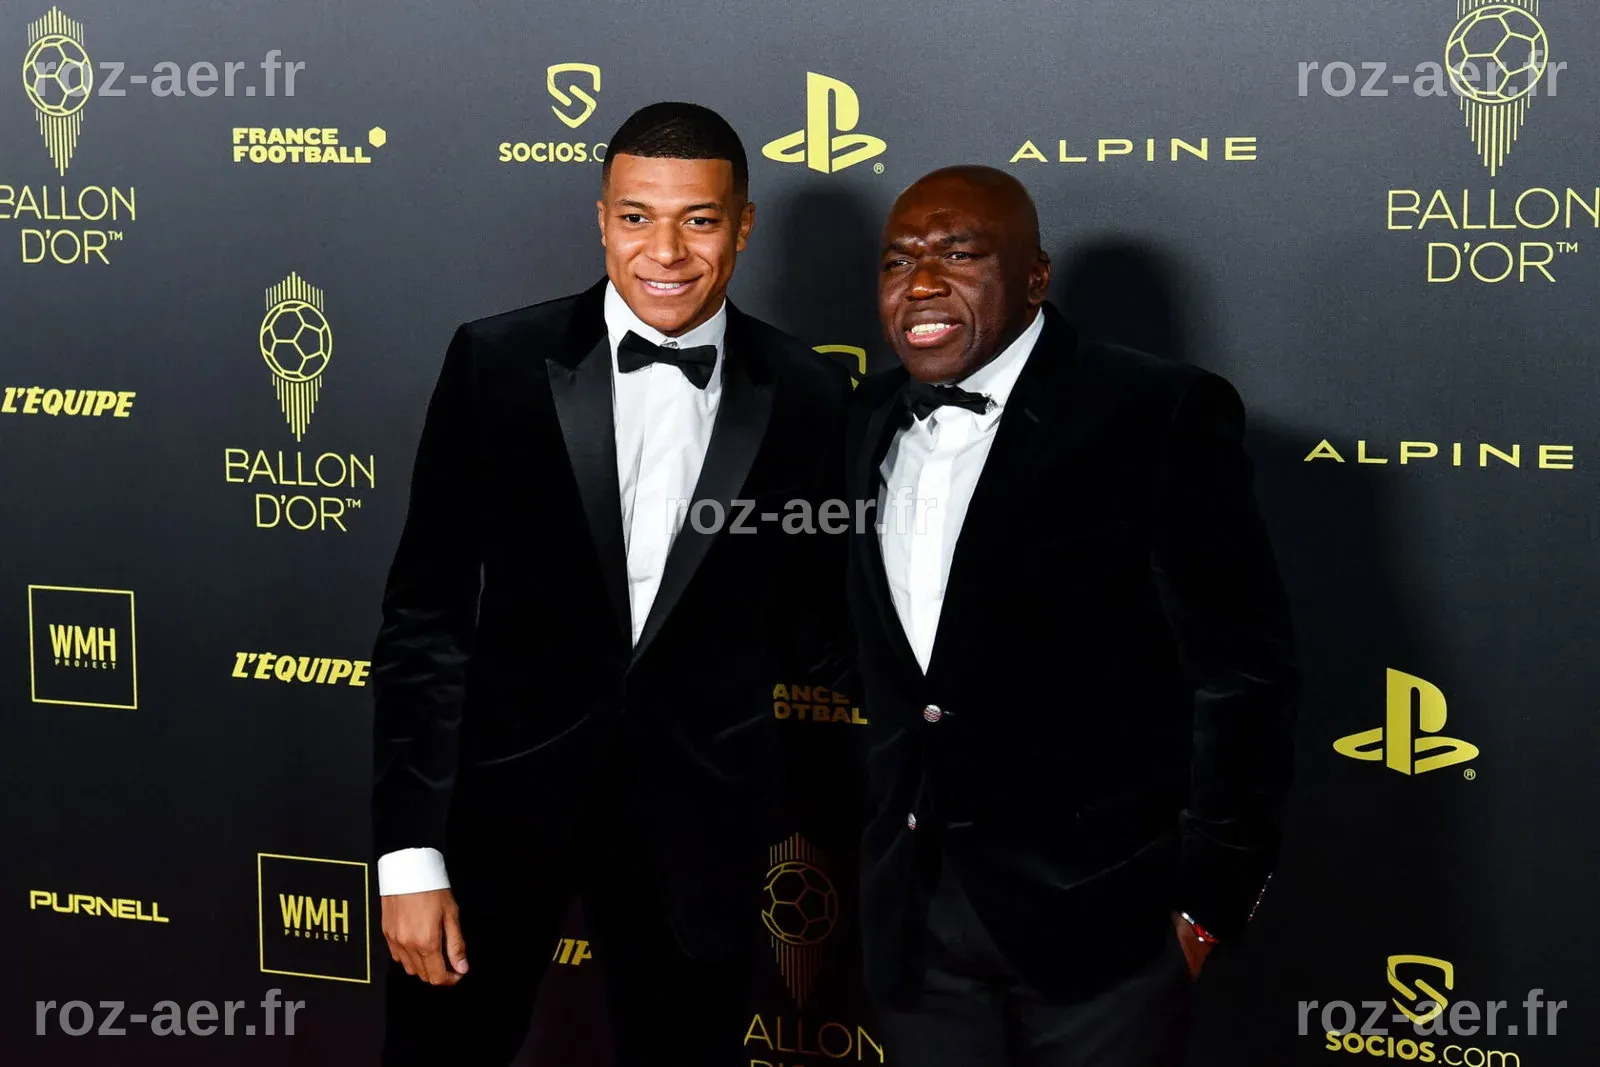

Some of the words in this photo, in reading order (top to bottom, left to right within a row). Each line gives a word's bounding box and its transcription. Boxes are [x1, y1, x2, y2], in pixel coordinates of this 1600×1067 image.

[232, 127, 339, 145] FRANCE
[1009, 136, 1257, 163] ALPINE
[233, 146, 371, 163] FOOTBALL
[498, 142, 608, 162] SOCIOS.c
[0, 184, 136, 221] BALLON
[1388, 187, 1600, 231] BALLON
[225, 448, 375, 489] BALLON
[1304, 439, 1574, 470] ALPINE
[49, 624, 116, 662] WMH
[54, 658, 116, 670] PROJECT
[772, 683, 851, 705] ANCE
[773, 701, 869, 725] OTBAL
[29, 890, 169, 923] PURNELL
[279, 893, 348, 934] WMH
[284, 929, 348, 942] PROJECT
[743, 1013, 885, 1063] ALLON
